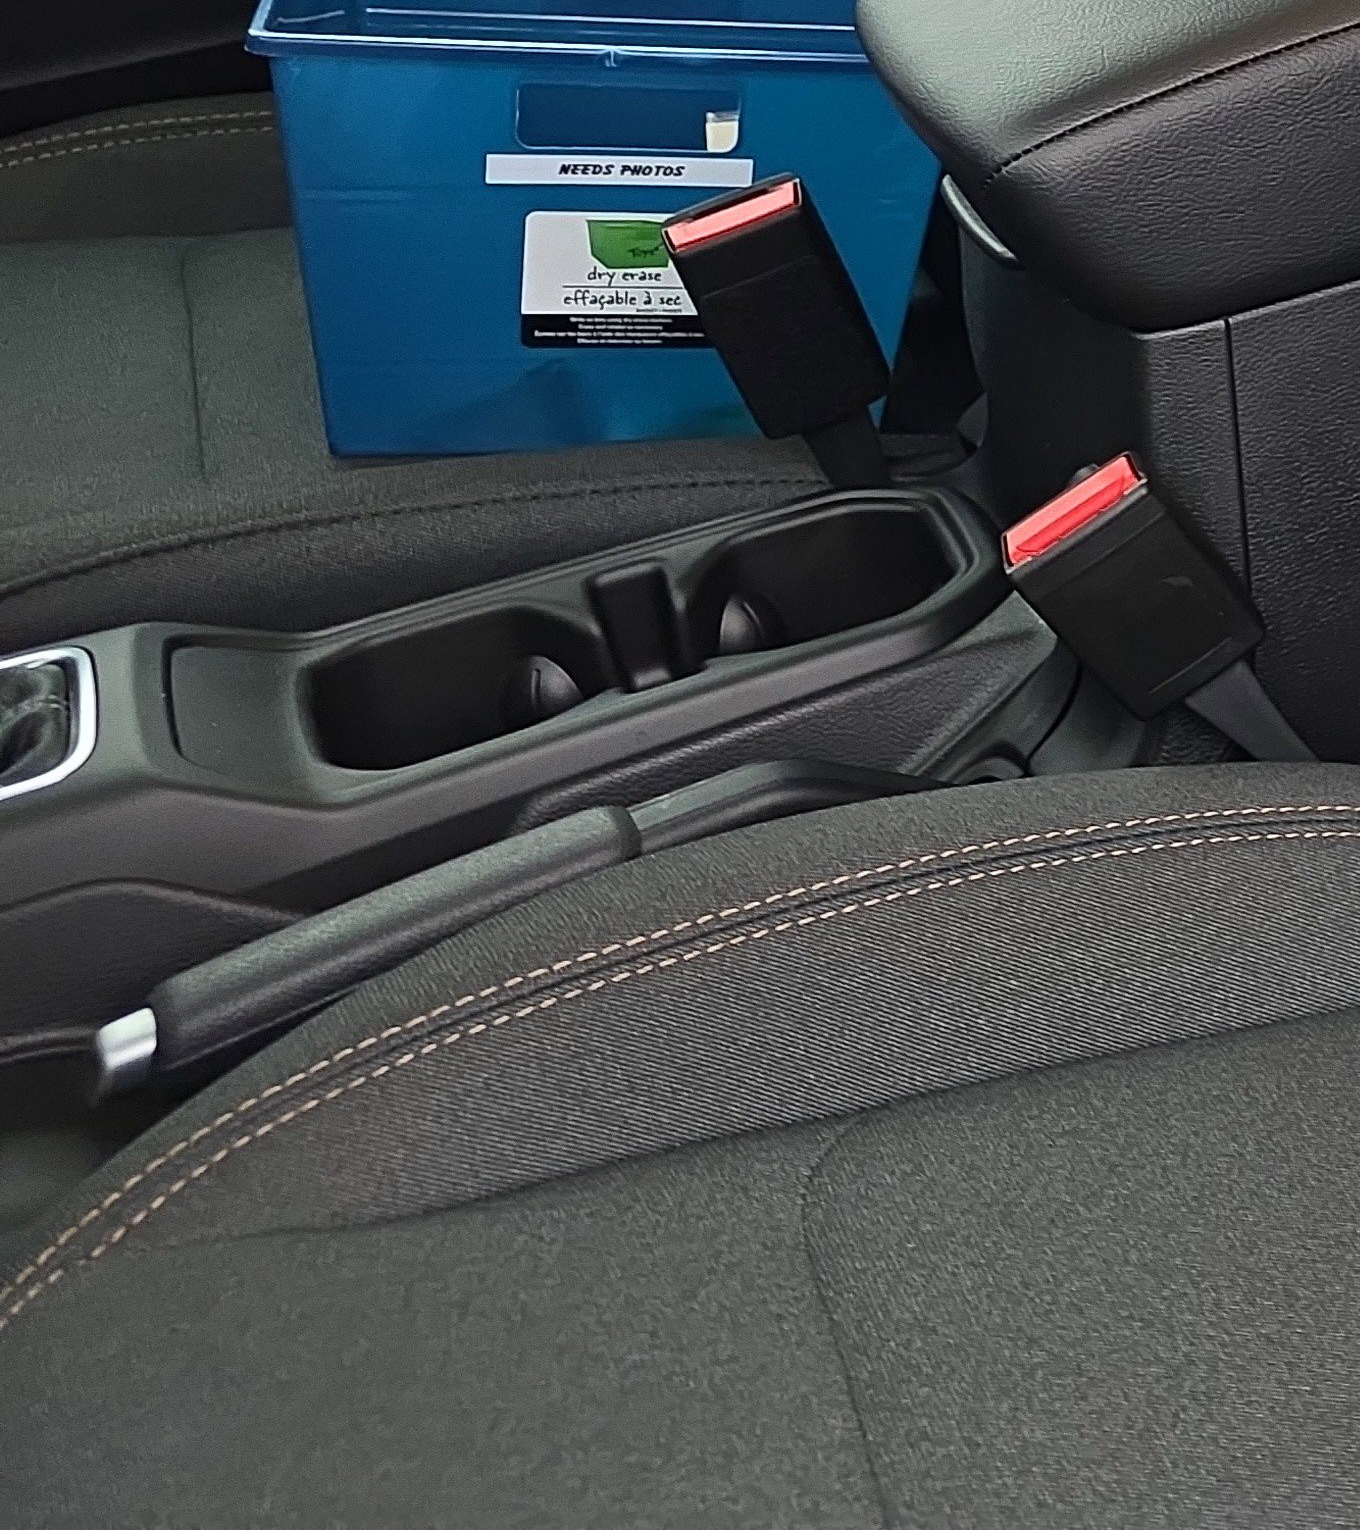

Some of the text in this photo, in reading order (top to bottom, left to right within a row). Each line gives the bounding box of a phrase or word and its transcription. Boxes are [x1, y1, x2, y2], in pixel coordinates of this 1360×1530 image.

[559, 163, 685, 177] NEEDS PHOTOS
[587, 266, 661, 287] dry erase
[563, 289, 682, 310] effaçable à sec
